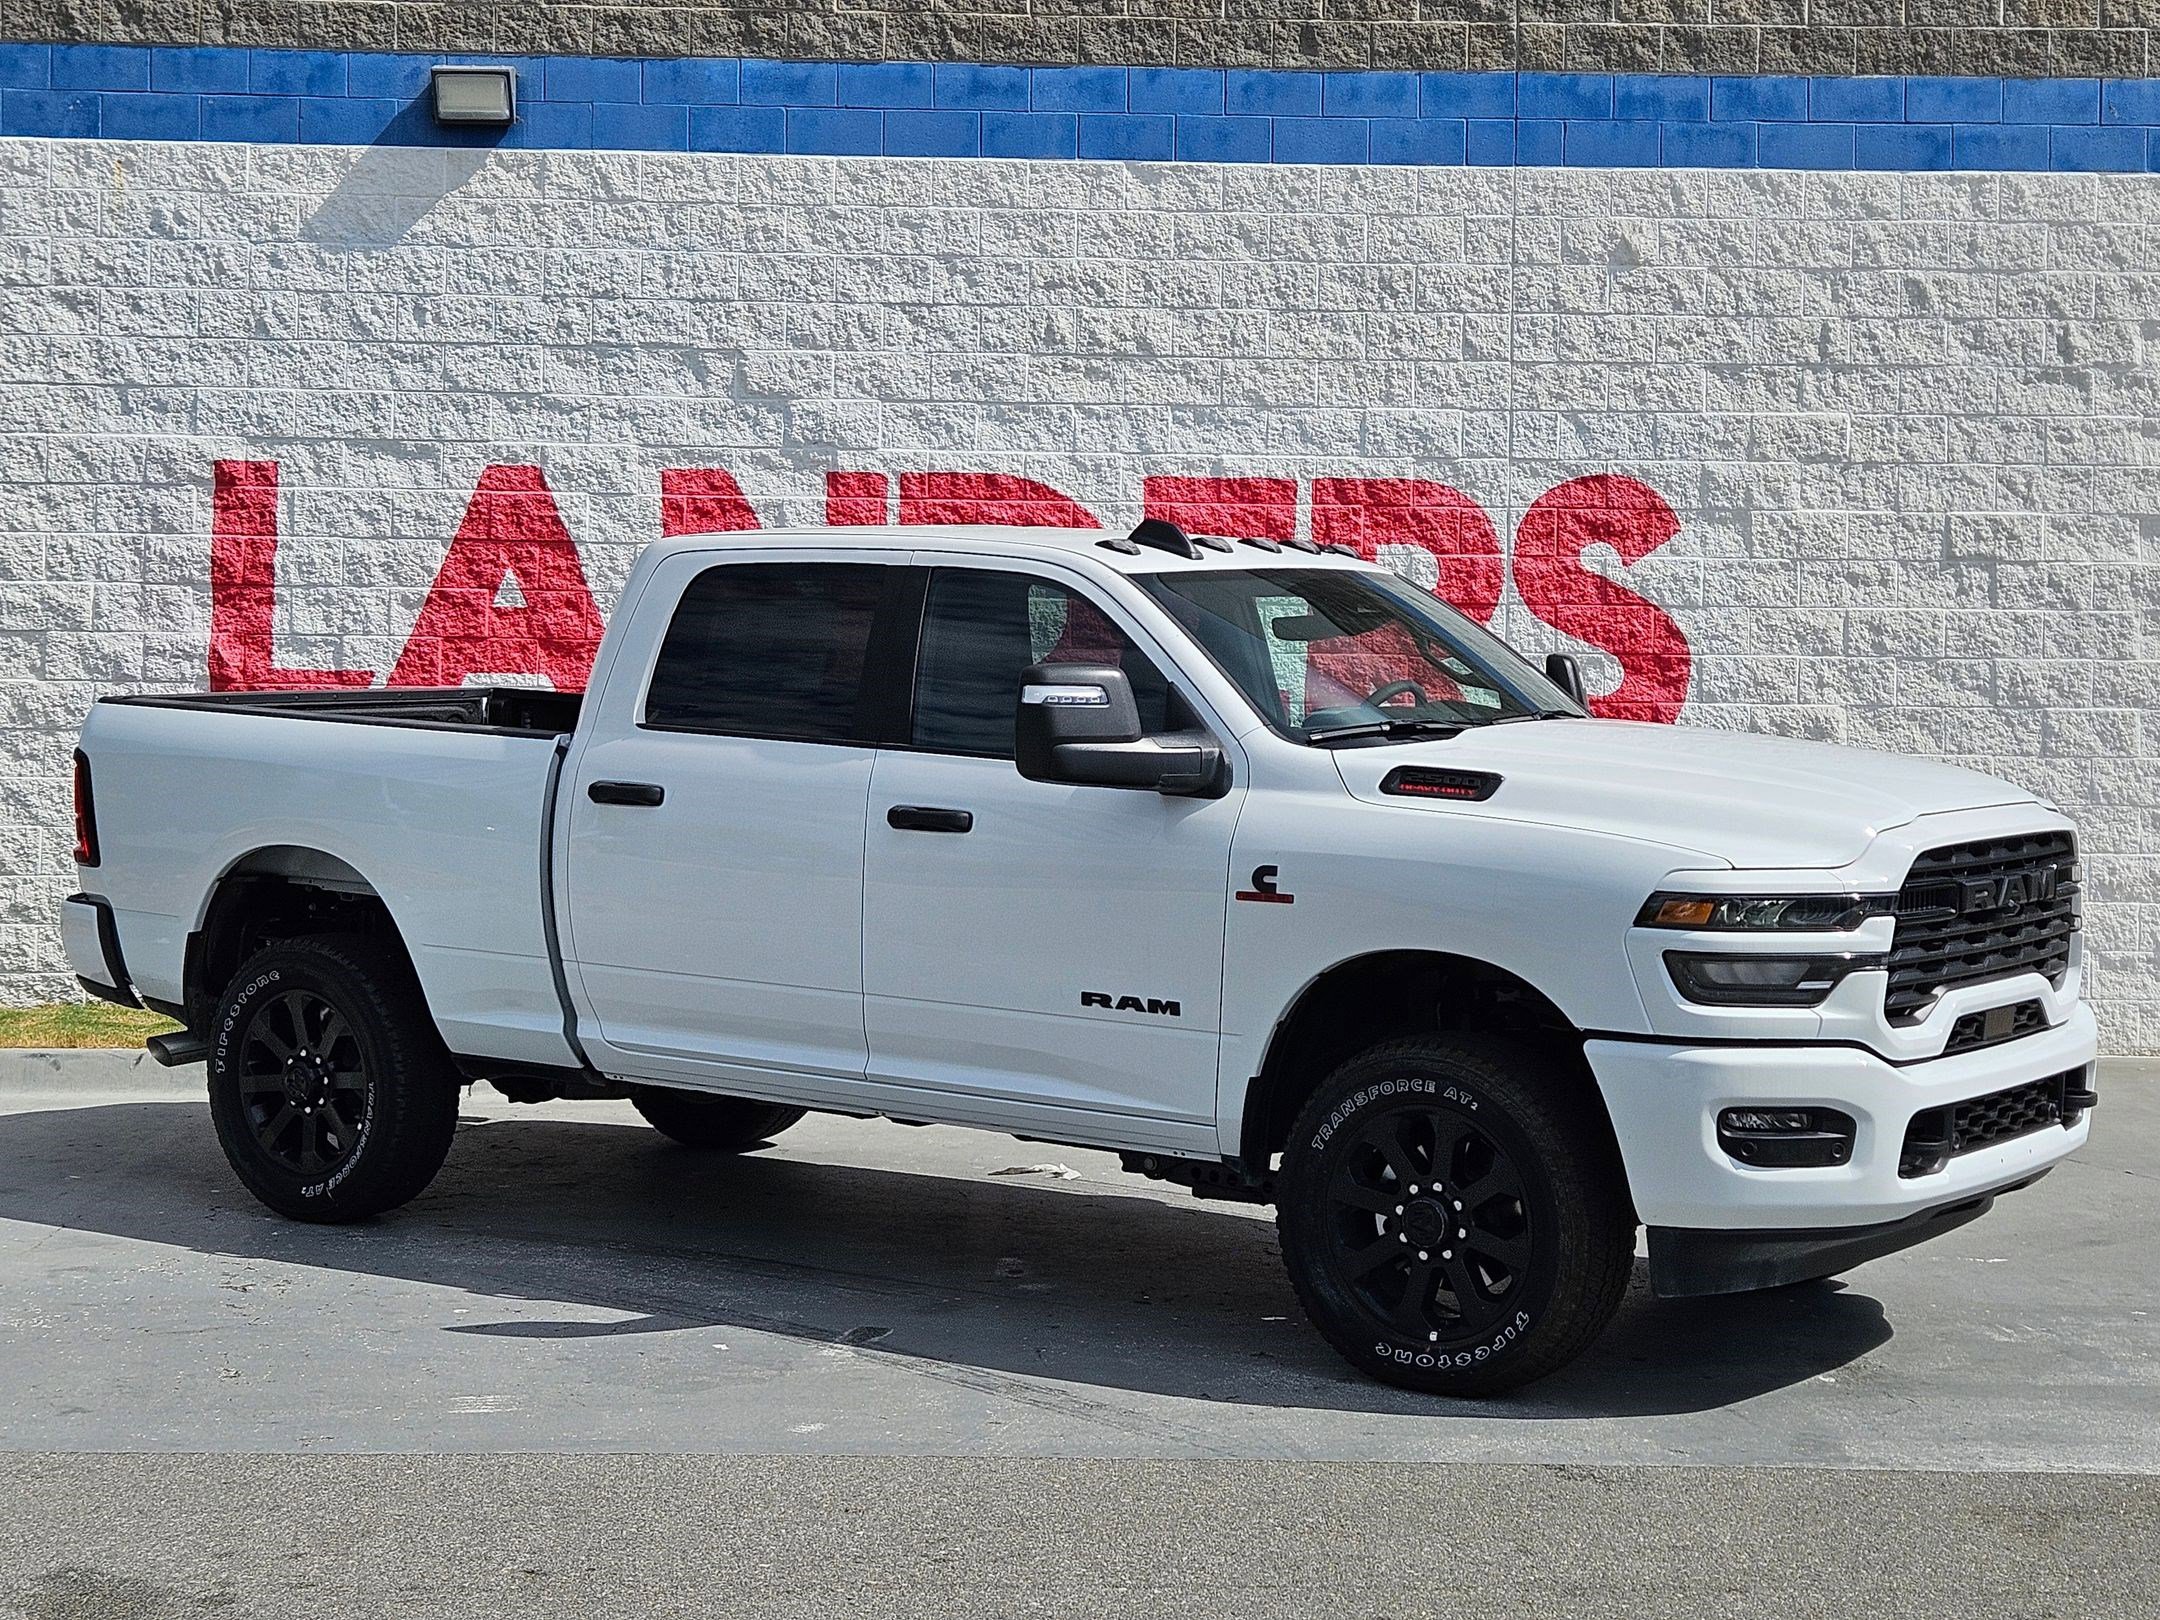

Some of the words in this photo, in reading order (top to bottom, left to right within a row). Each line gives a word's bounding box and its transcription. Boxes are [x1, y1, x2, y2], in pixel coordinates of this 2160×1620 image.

[209, 460, 1692, 724] LARS
[1960, 866, 2058, 914] RAM
[1080, 991, 1181, 1017] RAM
[1311, 1078, 1437, 1151] TRANSFORCE
